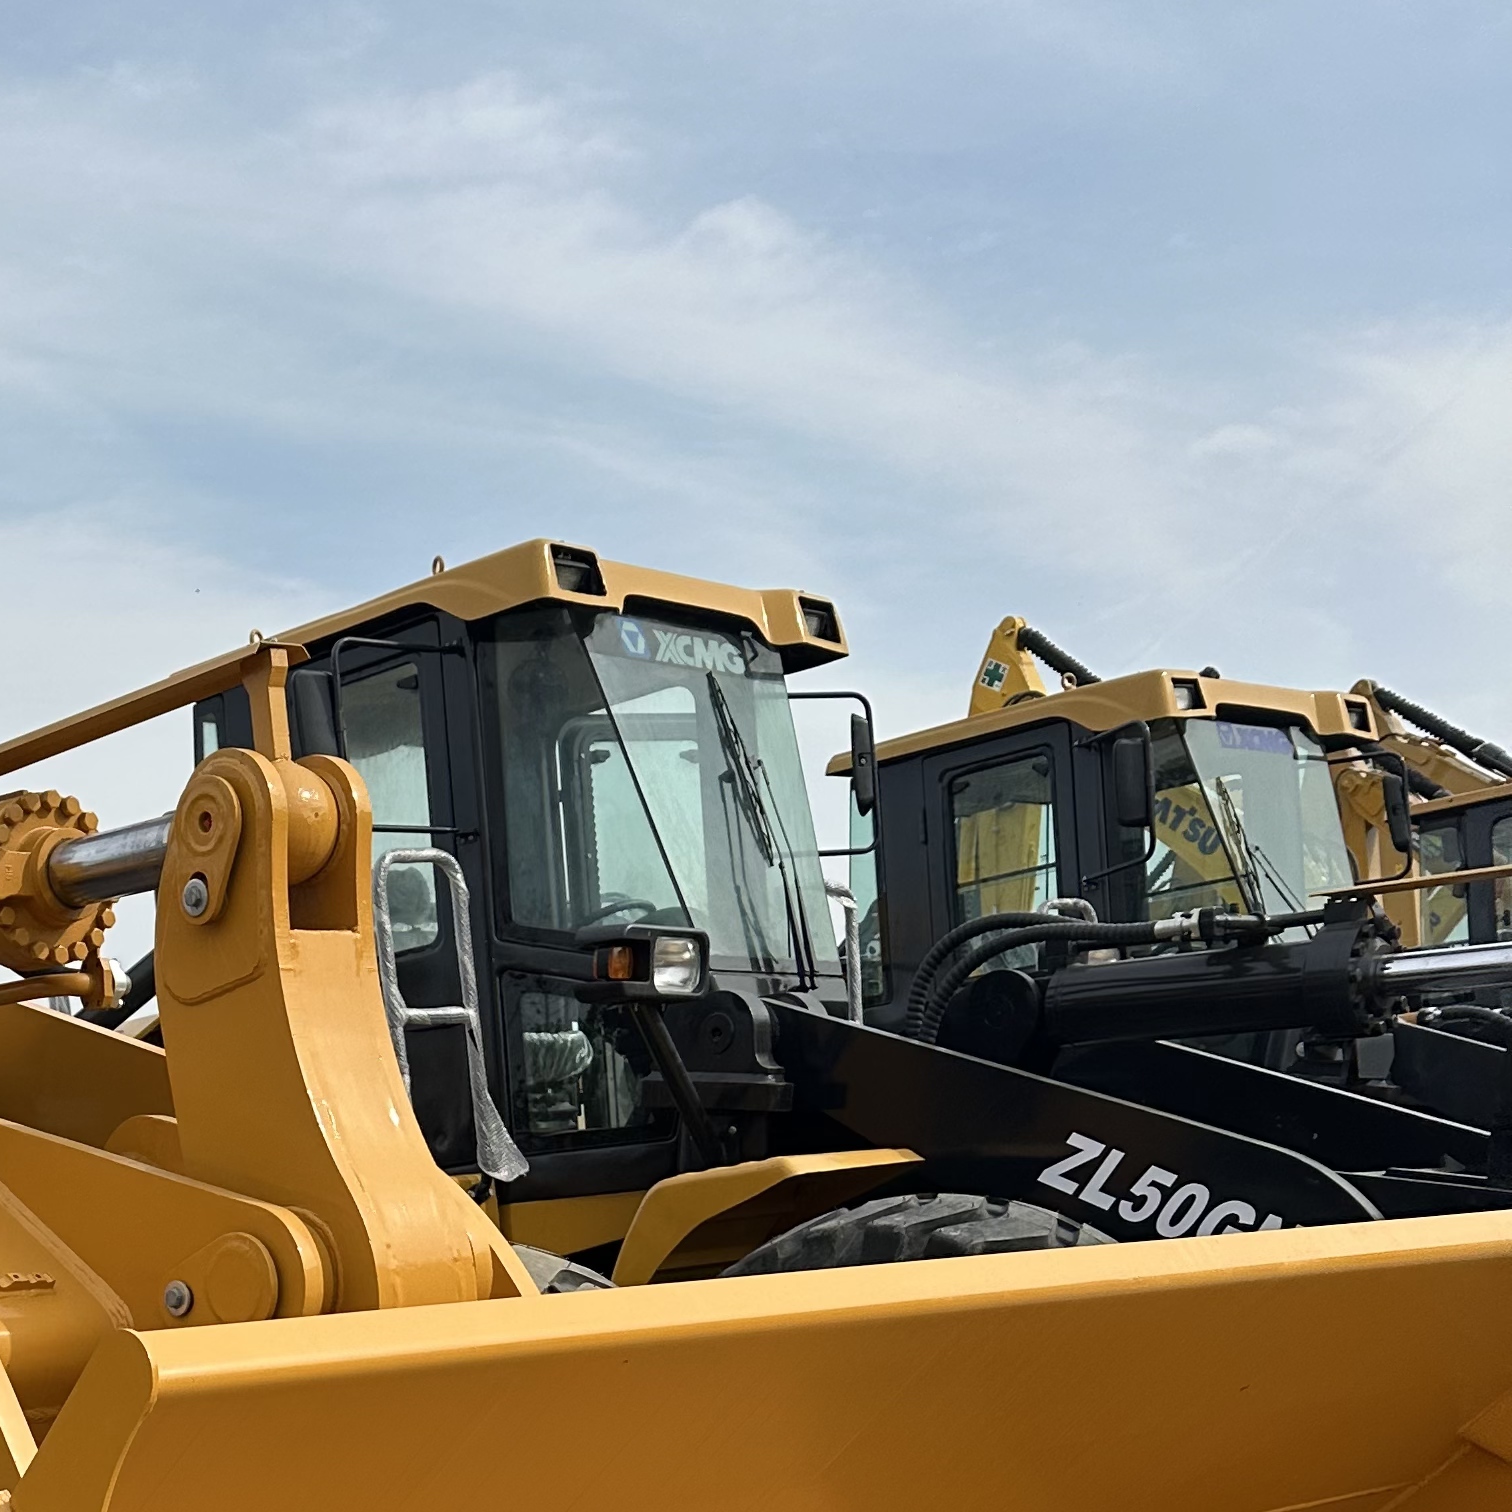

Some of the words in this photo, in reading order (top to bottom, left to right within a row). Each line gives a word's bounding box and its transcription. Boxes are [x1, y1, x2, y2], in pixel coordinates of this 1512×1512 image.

[652, 628, 746, 674] XCMG
[1153, 797, 1221, 855] ATSU
[1037, 1131, 1302, 1238] ZL50G
